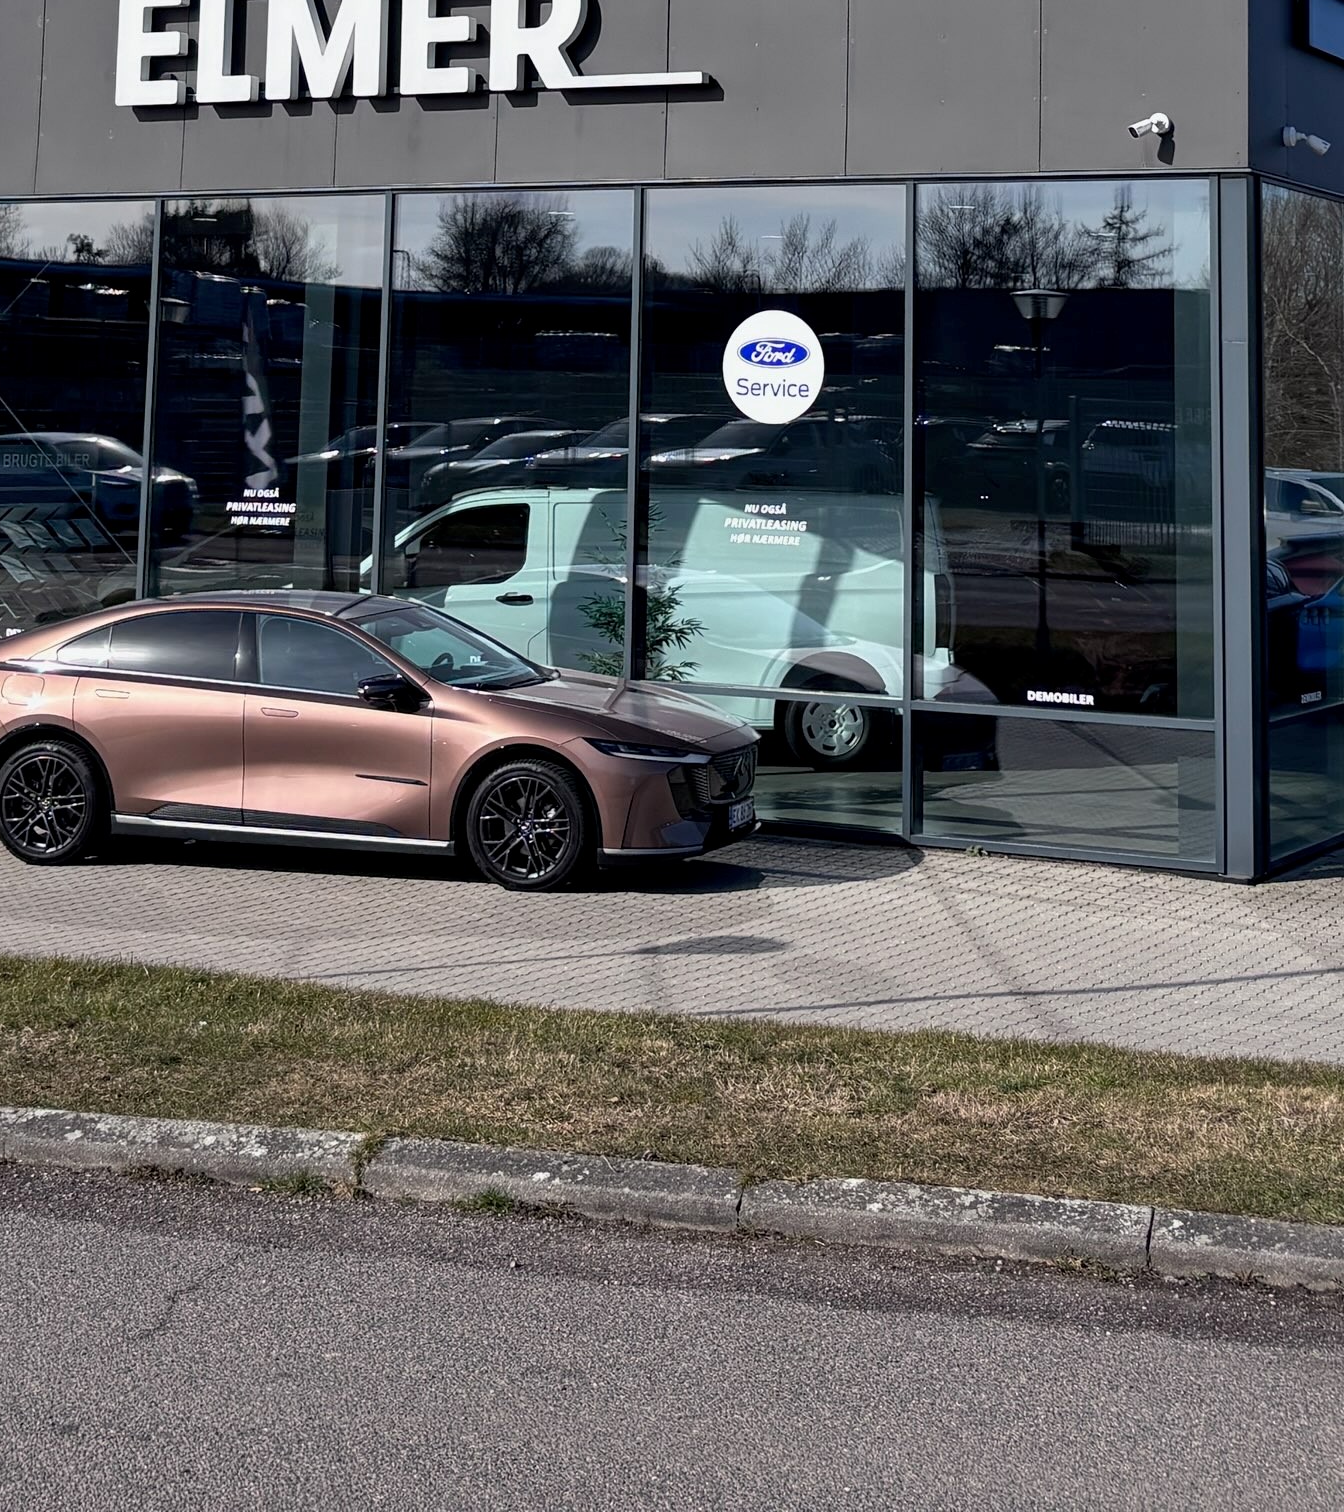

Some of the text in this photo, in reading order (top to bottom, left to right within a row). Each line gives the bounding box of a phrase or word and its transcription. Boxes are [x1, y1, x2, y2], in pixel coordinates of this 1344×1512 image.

[750, 341, 797, 363] Ford
[736, 378, 810, 398] Service
[2, 454, 53, 468] BRUGTE
[243, 487, 280, 498] NU OGSÅ
[225, 501, 297, 513] PRIVATLEASING
[744, 502, 787, 515] NU OGSÅ
[230, 516, 249, 526] HØR
[724, 518, 808, 532] PRIVATLEASING
[730, 533, 801, 546] HØR NÆRMERE
[1027, 690, 1095, 706] DEMOBILER
